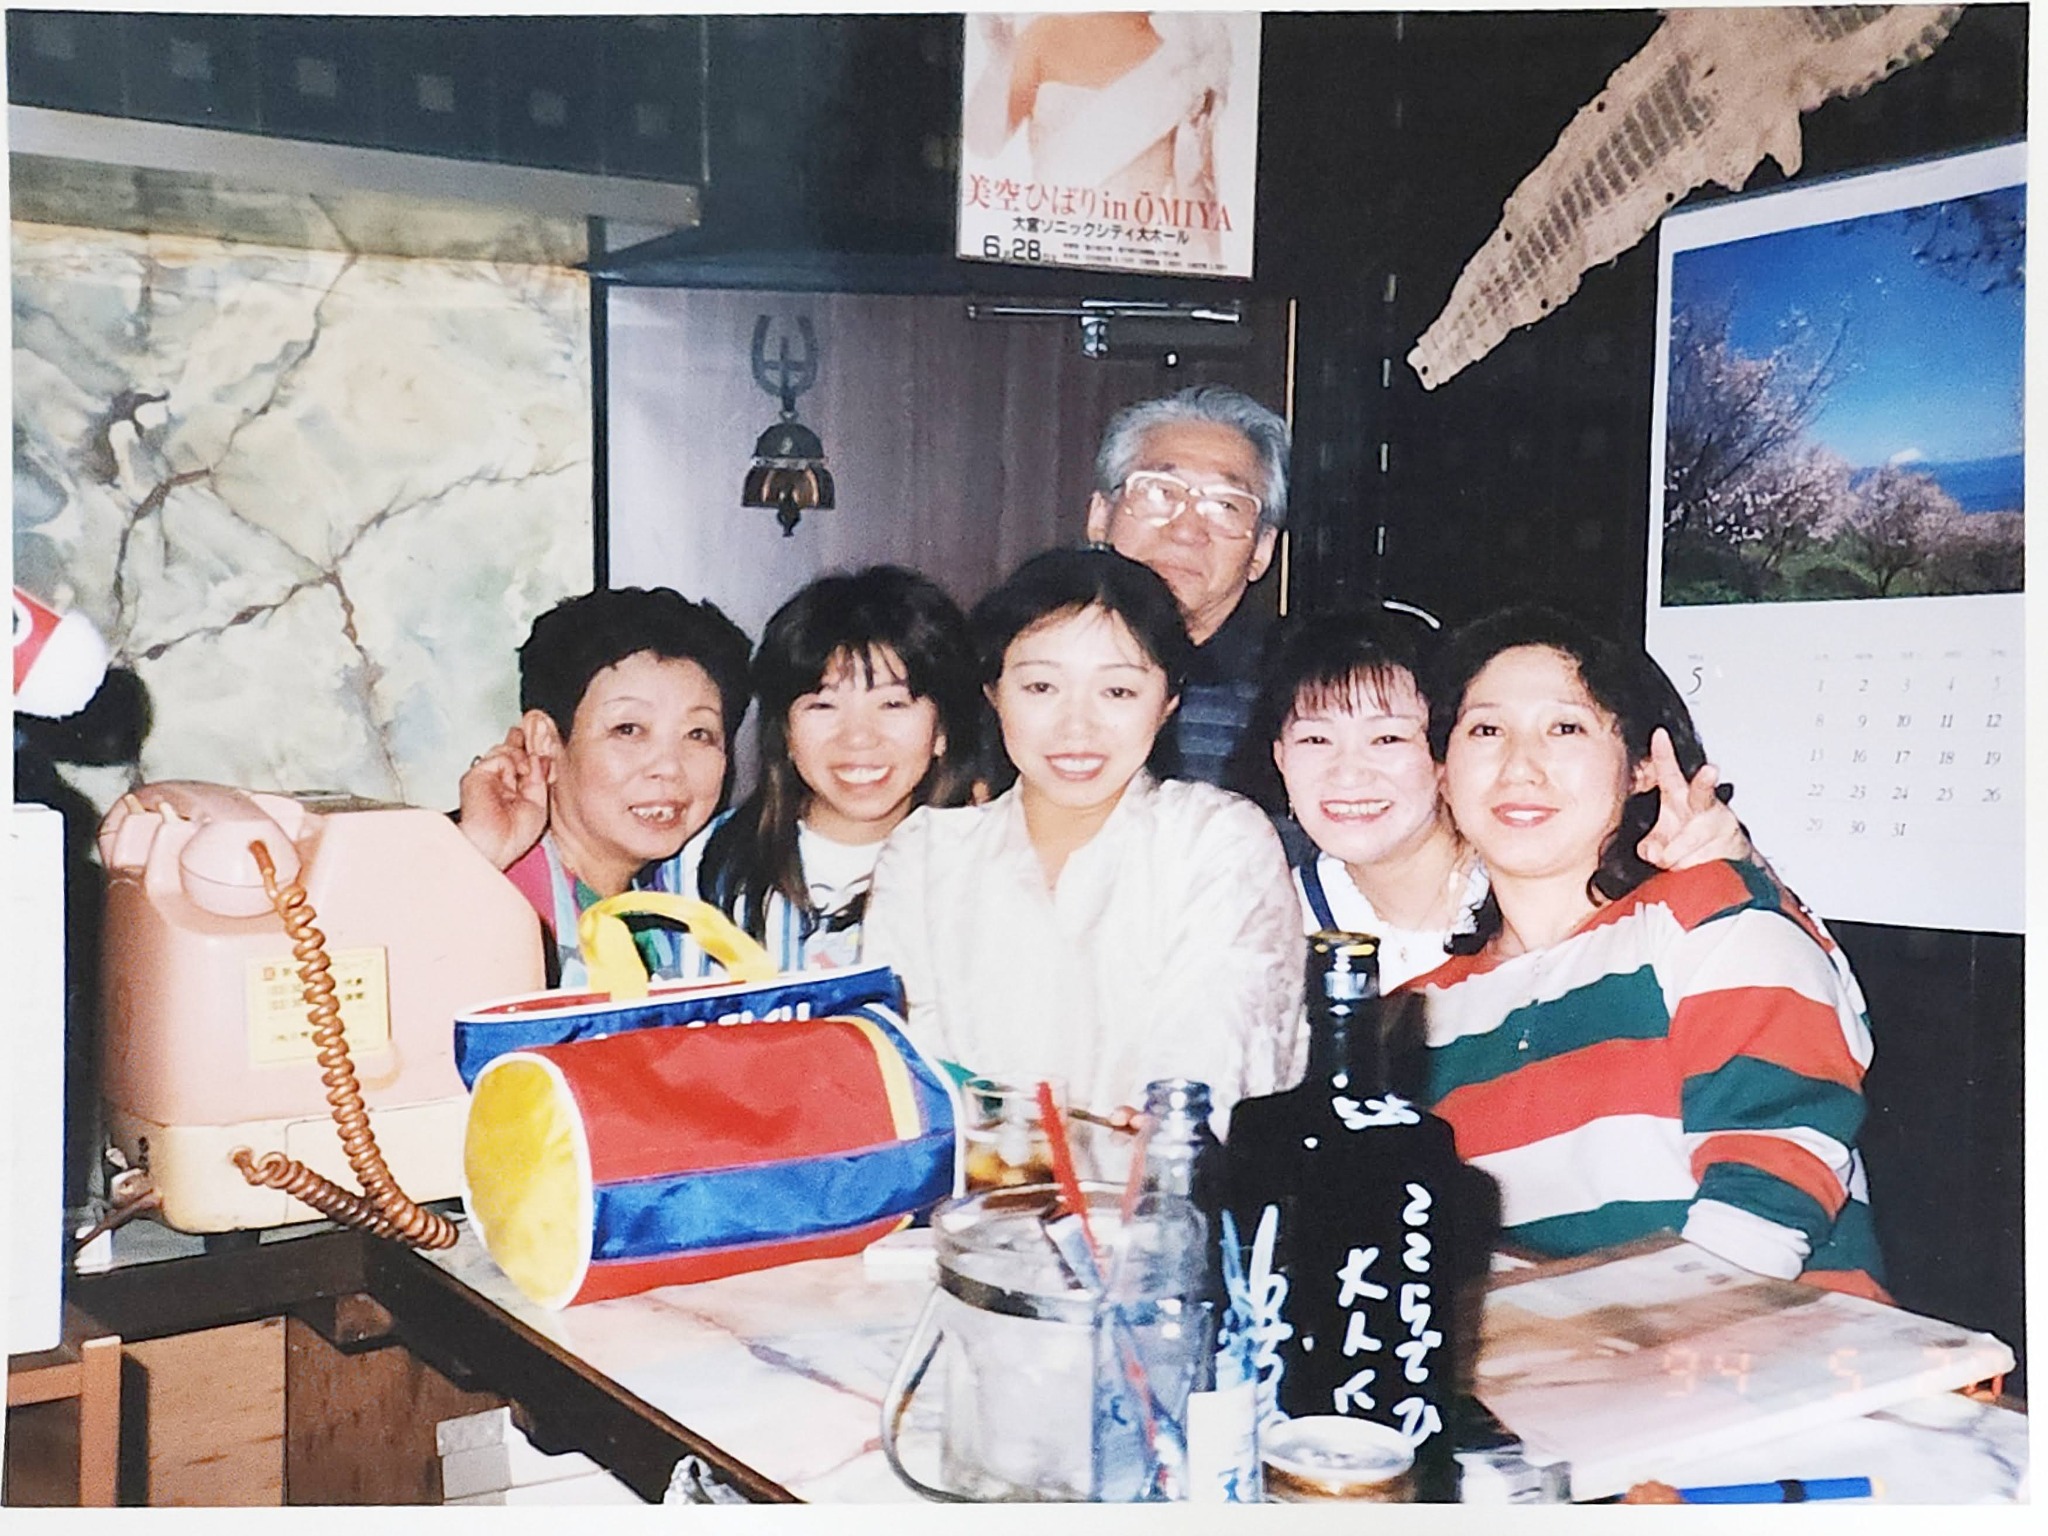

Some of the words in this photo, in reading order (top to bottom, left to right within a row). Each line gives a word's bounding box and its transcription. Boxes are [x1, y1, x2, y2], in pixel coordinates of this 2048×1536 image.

[966, 174, 1096, 213] 美空ひばり
[1102, 191, 1128, 221] in
[1686, 666, 1703, 696] 5
[1896, 713, 1911, 728] 10
[1940, 713, 1954, 728] 11
[1985, 713, 2002, 728] 12
[1852, 749, 1868, 764] 16
[1895, 750, 1911, 764] 17
[1938, 751, 1955, 765] 18
[1984, 751, 2001, 766] 19
[1807, 783, 1825, 797] 22
[1849, 785, 1867, 799] 23
[1891, 786, 1909, 800] 24
[1936, 787, 1954, 802] 25
[1981, 788, 2002, 802] 26
[1849, 820, 1866, 835] 30
[1891, 822, 1907, 837] 31
